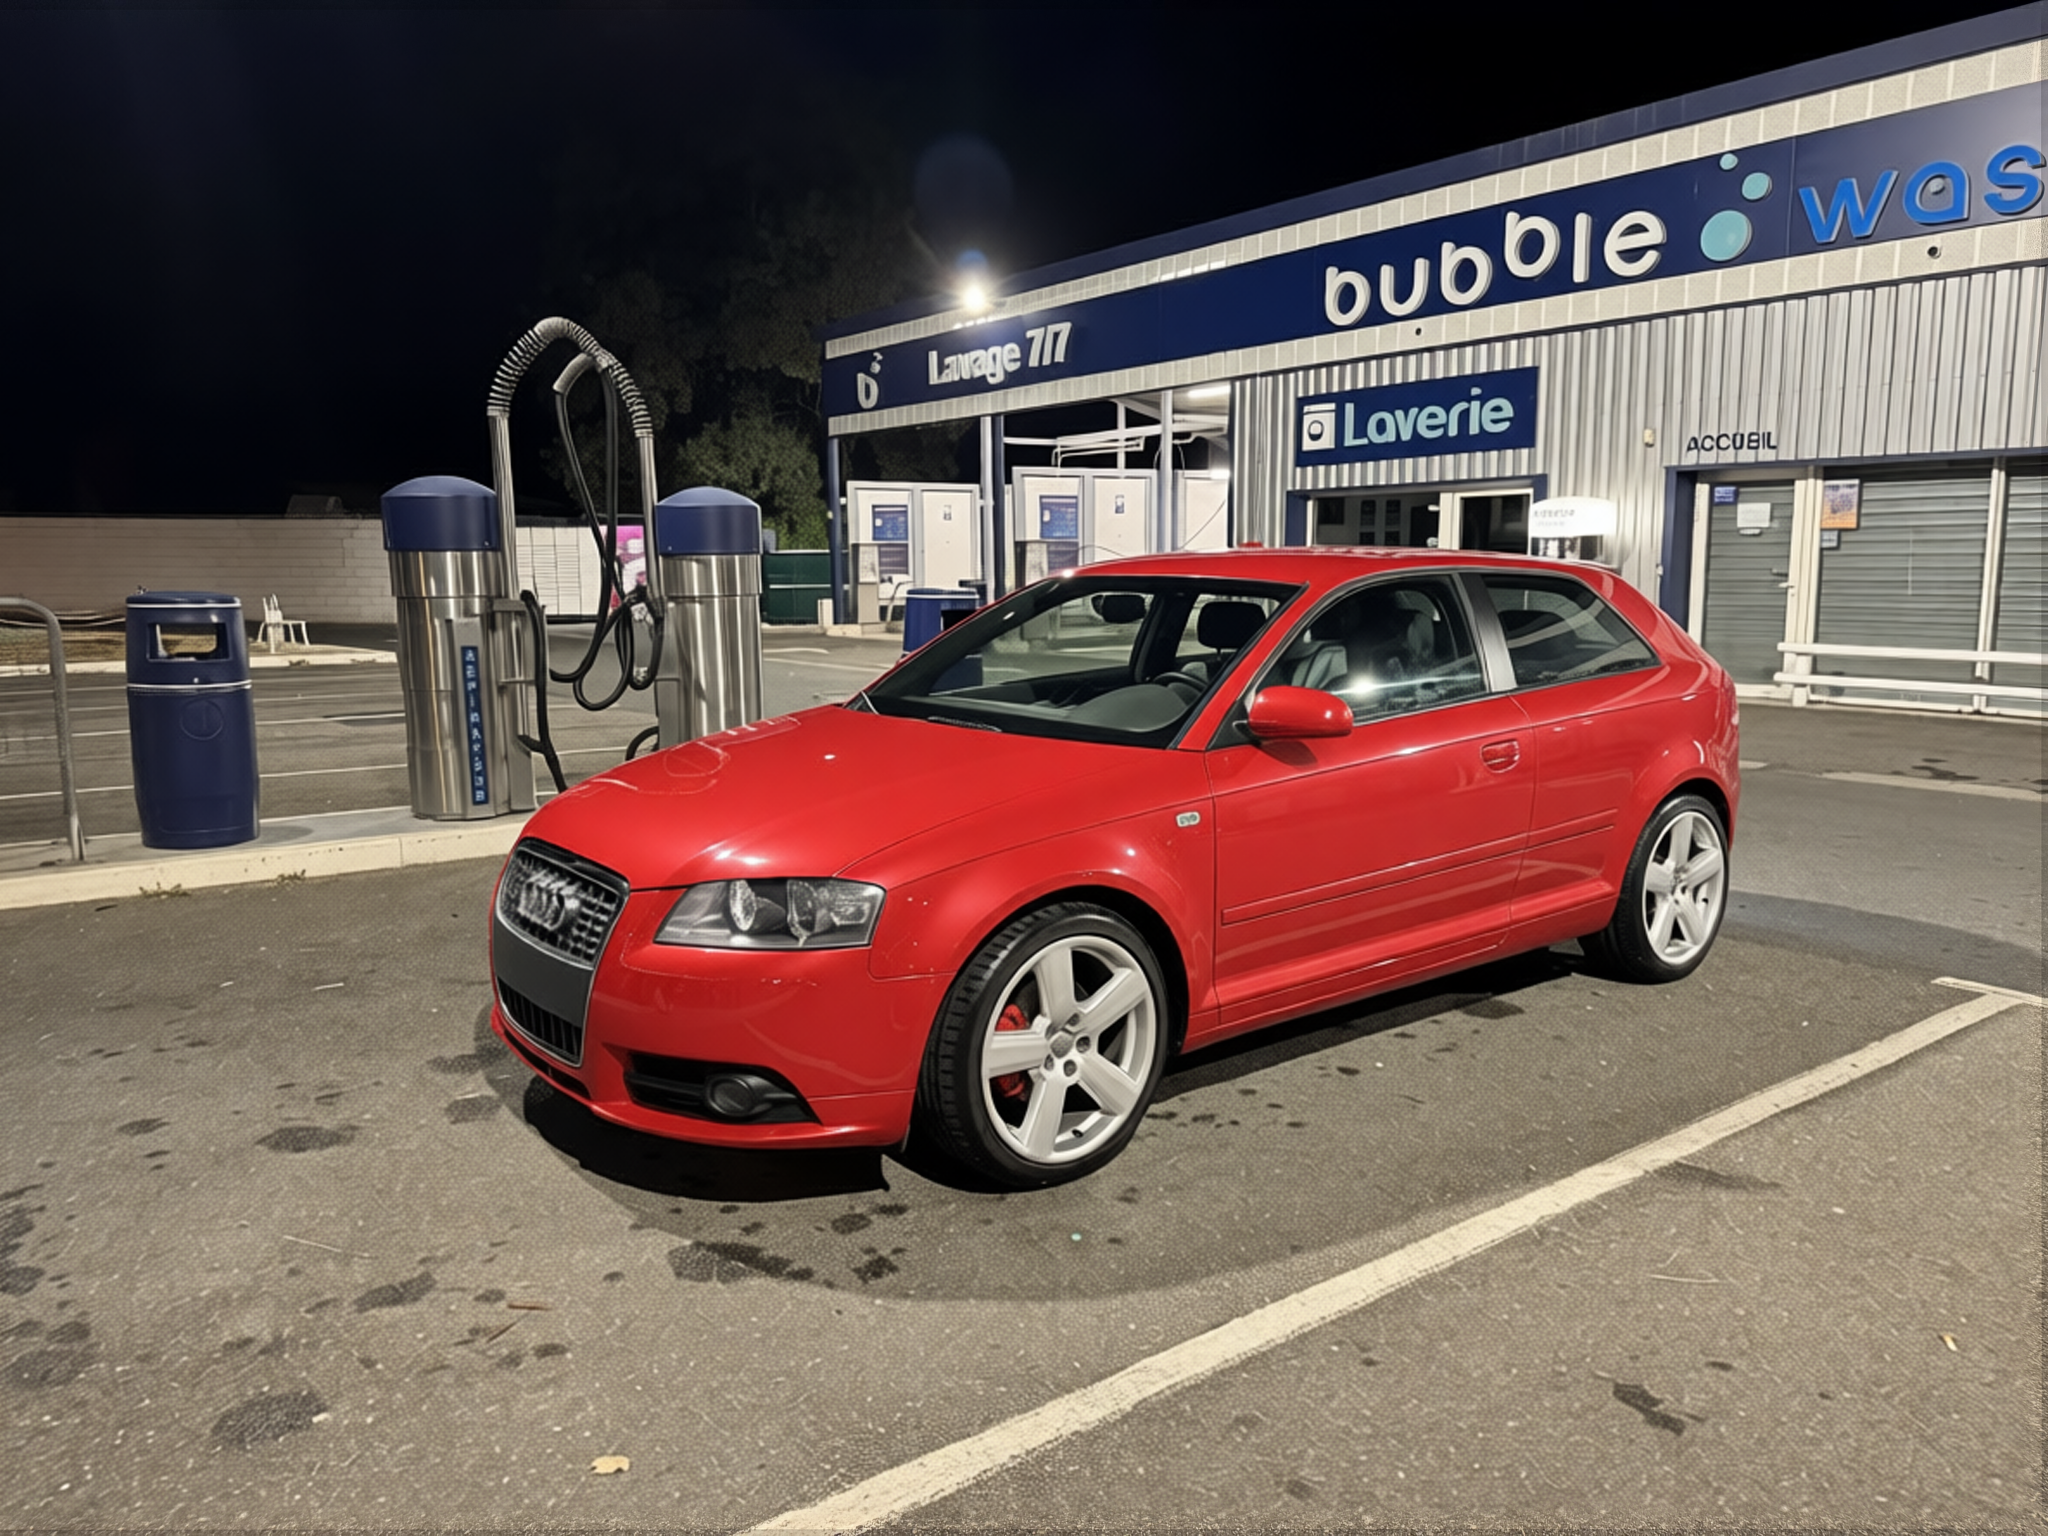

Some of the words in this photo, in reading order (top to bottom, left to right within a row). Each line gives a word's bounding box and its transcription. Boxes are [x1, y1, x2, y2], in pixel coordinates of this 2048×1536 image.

[1325, 210, 1667, 327] bubble
[1798, 144, 2047, 243] was
[1344, 387, 1514, 446] Laverie
